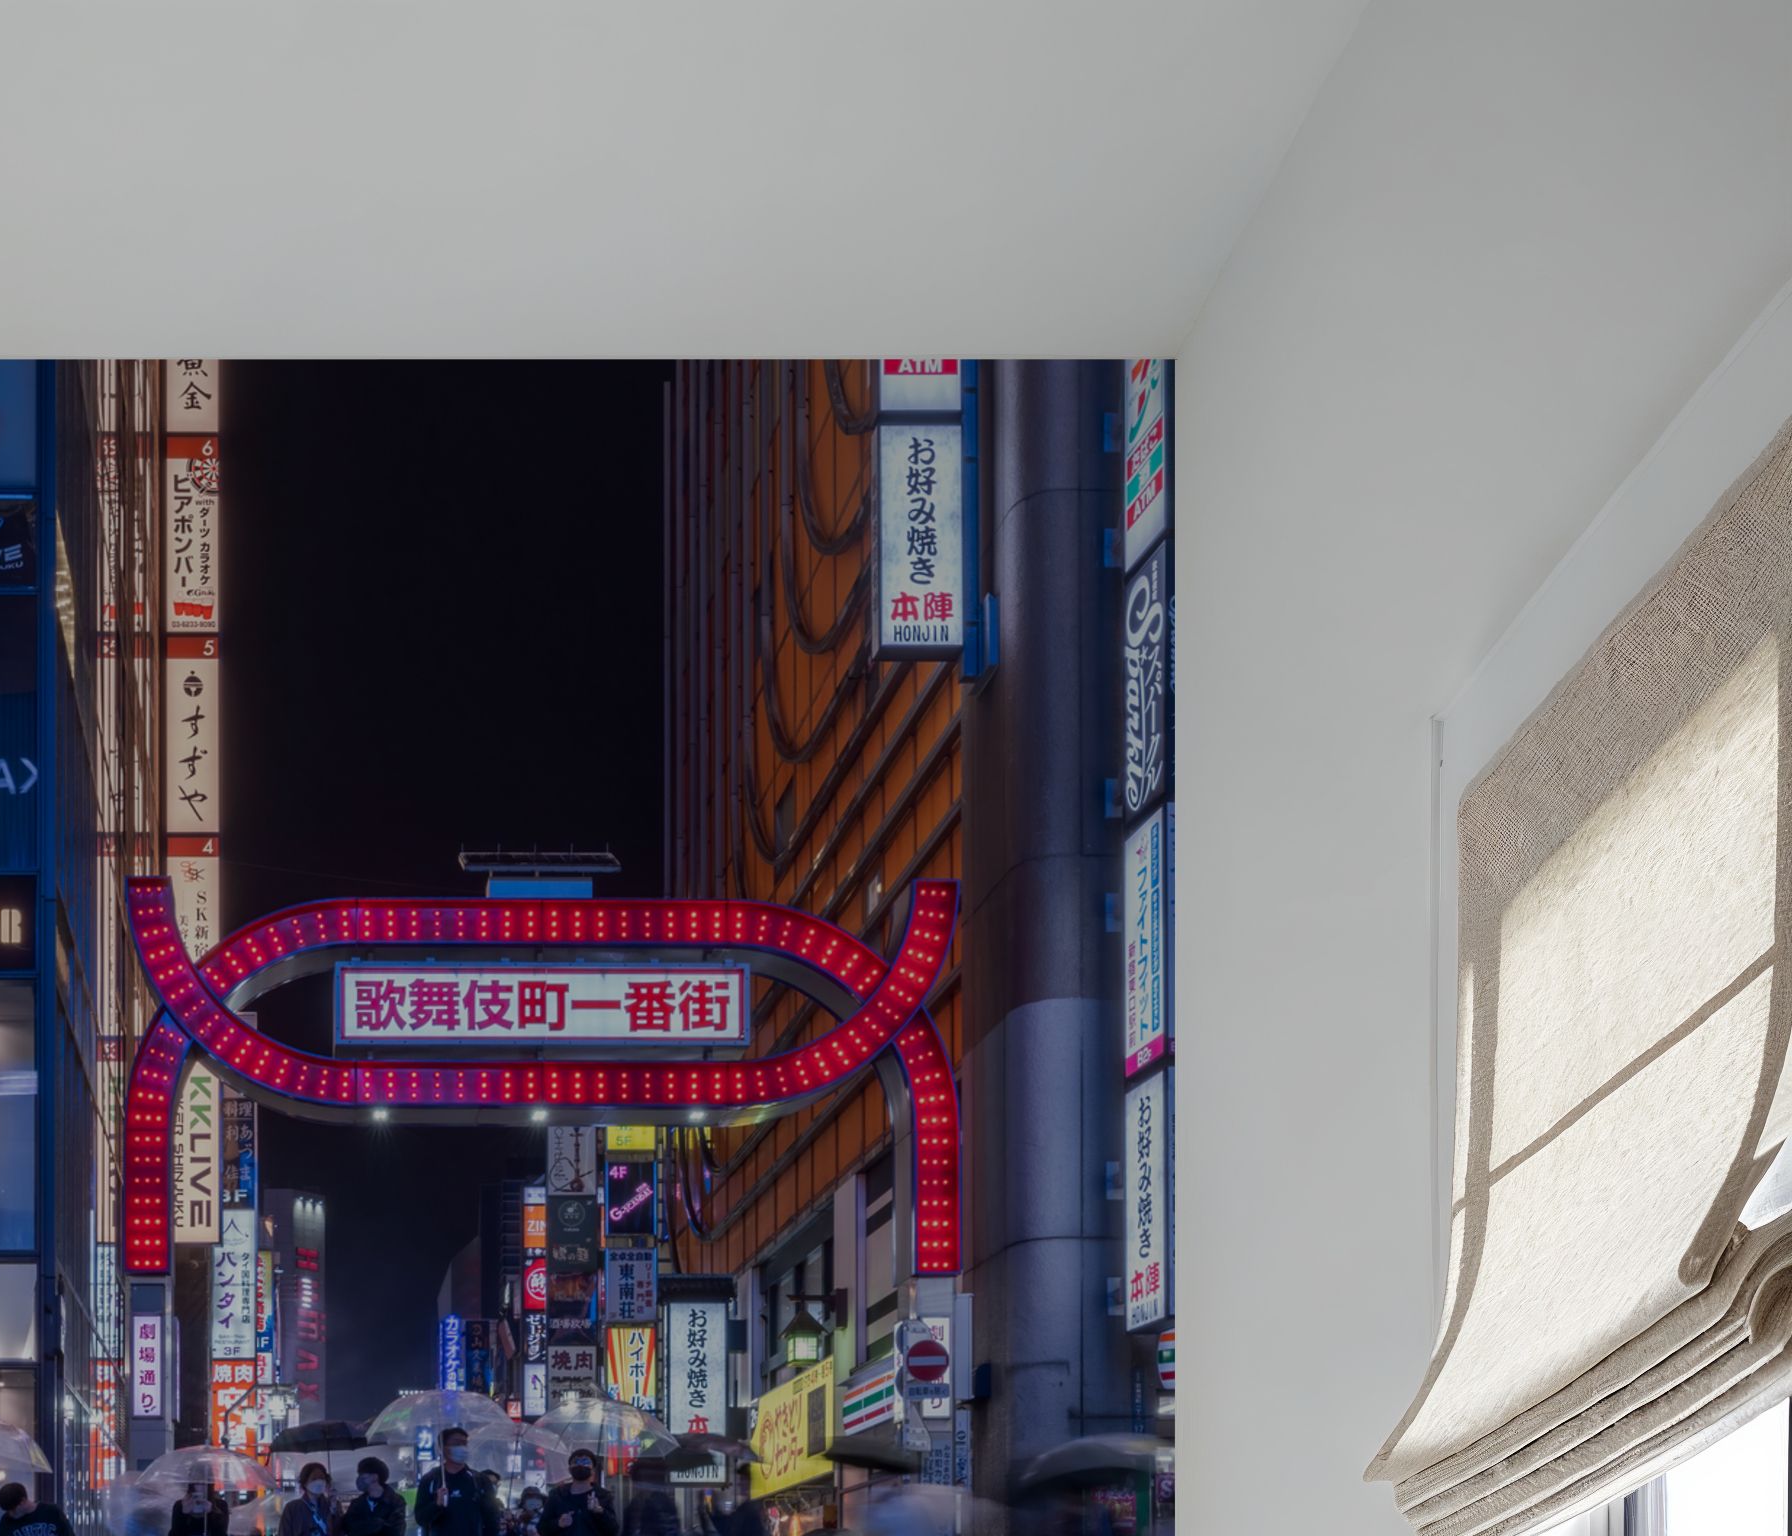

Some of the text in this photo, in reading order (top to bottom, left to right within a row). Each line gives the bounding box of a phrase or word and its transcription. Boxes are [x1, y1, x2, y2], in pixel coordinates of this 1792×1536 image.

[203, 440, 213, 456] 6
[174, 474, 193, 587] ビアポンバー
[907, 437, 937, 584] お好み焼き
[200, 542, 215, 586] カラオケ
[892, 592, 954, 621] 本陣
[203, 640, 214, 656] 5
[894, 624, 949, 642] HONJIN
[179, 705, 208, 821] すずや
[203, 839, 214, 854] 4
[354, 979, 730, 1031] 歌舞伎町一番街
[190, 1076, 212, 1228] KKLIVE
[609, 1166, 627, 1179] 4F
[1138, 1096, 1152, 1258] お好み焼き
[215, 1252, 236, 1328] バンタイ
[619, 1263, 635, 1318] 東南荘
[139, 1323, 156, 1412] 劇場通り
[213, 1365, 253, 1383] 焼肉
[224, 1347, 240, 1356] 3F
[551, 1350, 593, 1371] 焼肉
[629, 1328, 645, 1410] ハイボール
[688, 1308, 708, 1408] お好み焼き
